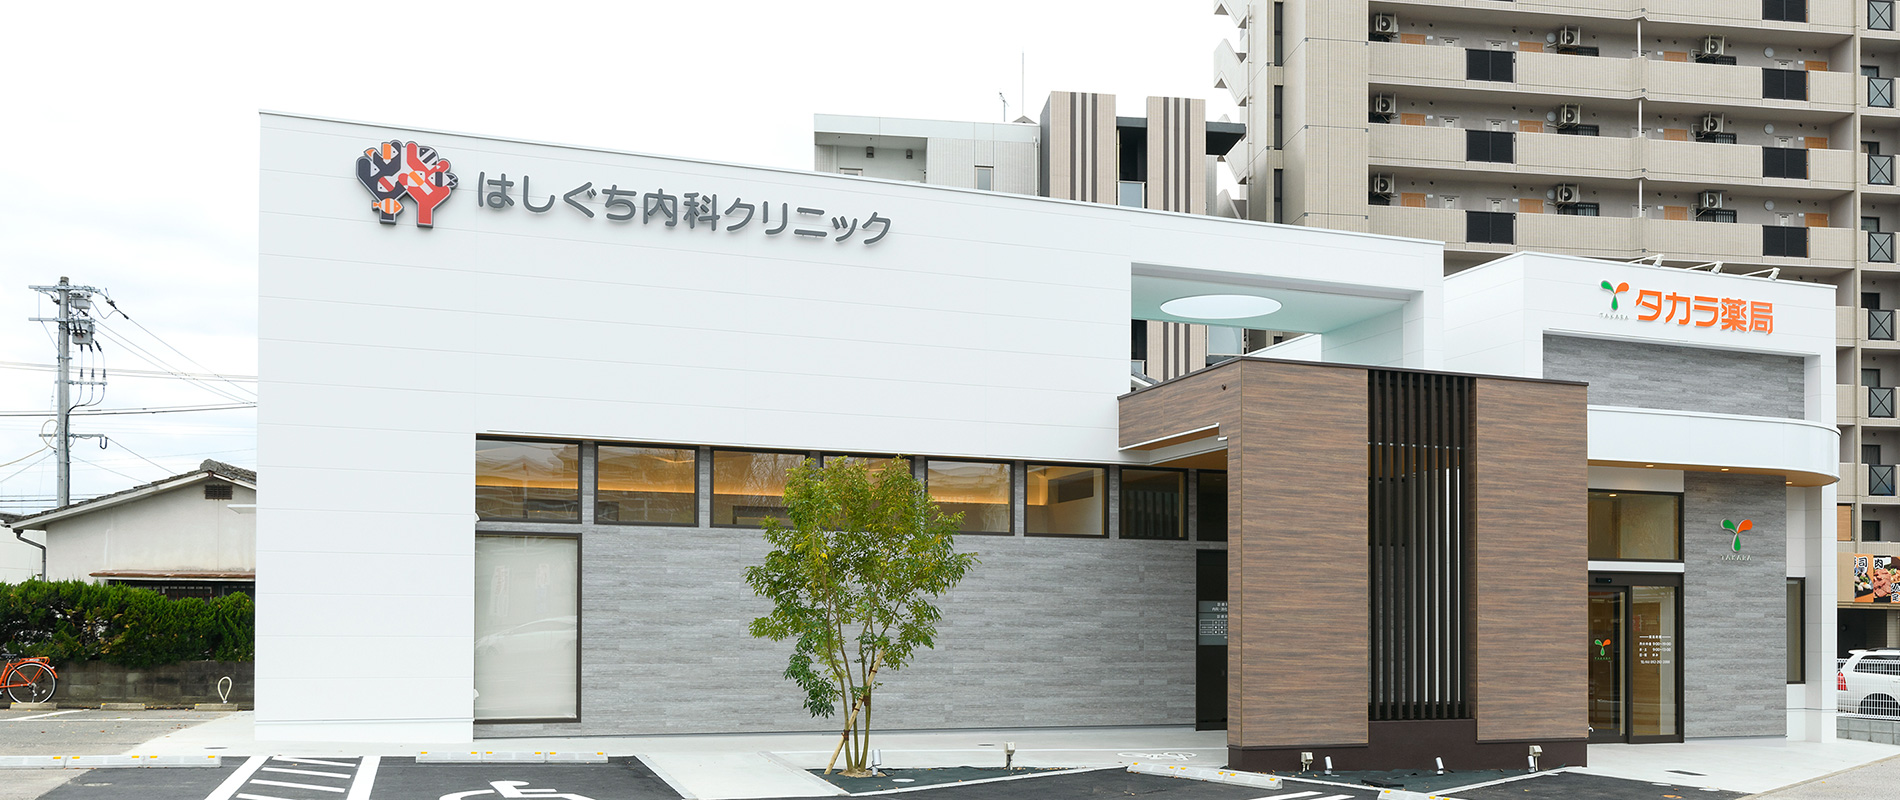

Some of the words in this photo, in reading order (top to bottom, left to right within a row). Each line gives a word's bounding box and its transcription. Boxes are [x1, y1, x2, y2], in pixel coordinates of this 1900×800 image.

[477, 171, 891, 244] はしぐち内科クリニック
[1635, 289, 1774, 335] タカラ薬局
